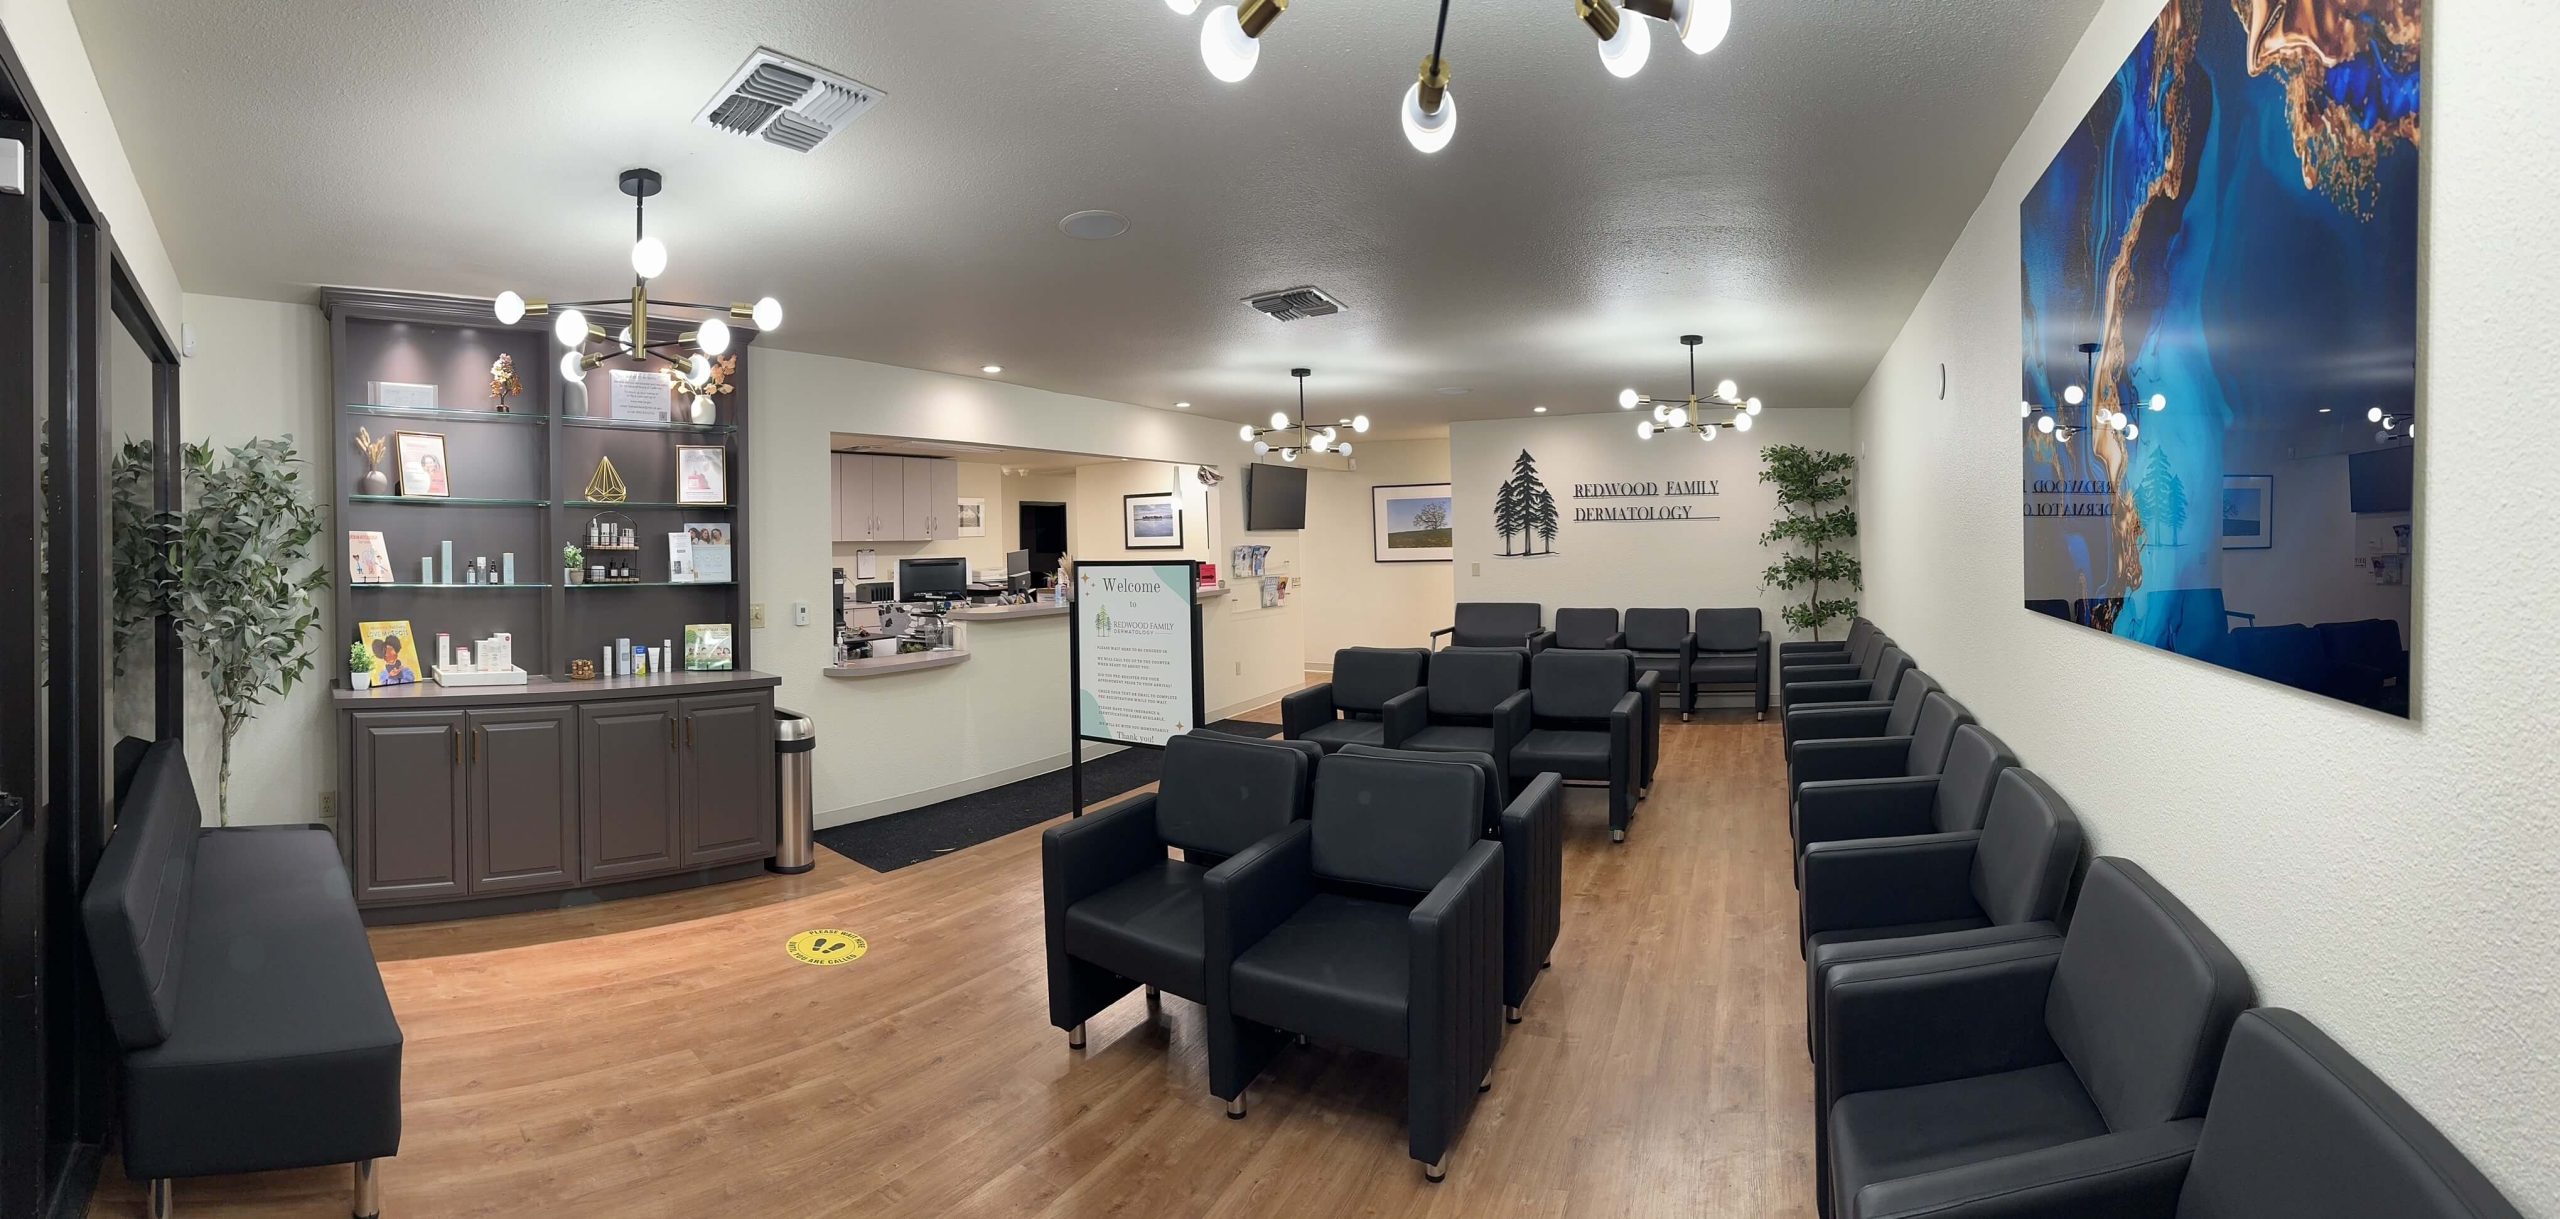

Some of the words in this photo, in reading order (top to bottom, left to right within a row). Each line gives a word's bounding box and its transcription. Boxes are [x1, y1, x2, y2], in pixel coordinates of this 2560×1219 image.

[1574, 482, 1657, 497] REDWOOD
[1666, 480, 1719, 495] FAMILY
[1575, 505, 1693, 521] DERMATOLOGY
[1102, 577, 1161, 593] Welcome
[1113, 621, 1149, 630] REDWOOD
[1150, 622, 1175, 631] FAMILY
[1117, 730, 1138, 741] Thank
[1139, 734, 1154, 744] you!
[841, 931, 858, 939] WAIT
[828, 954, 857, 965] CALLED
